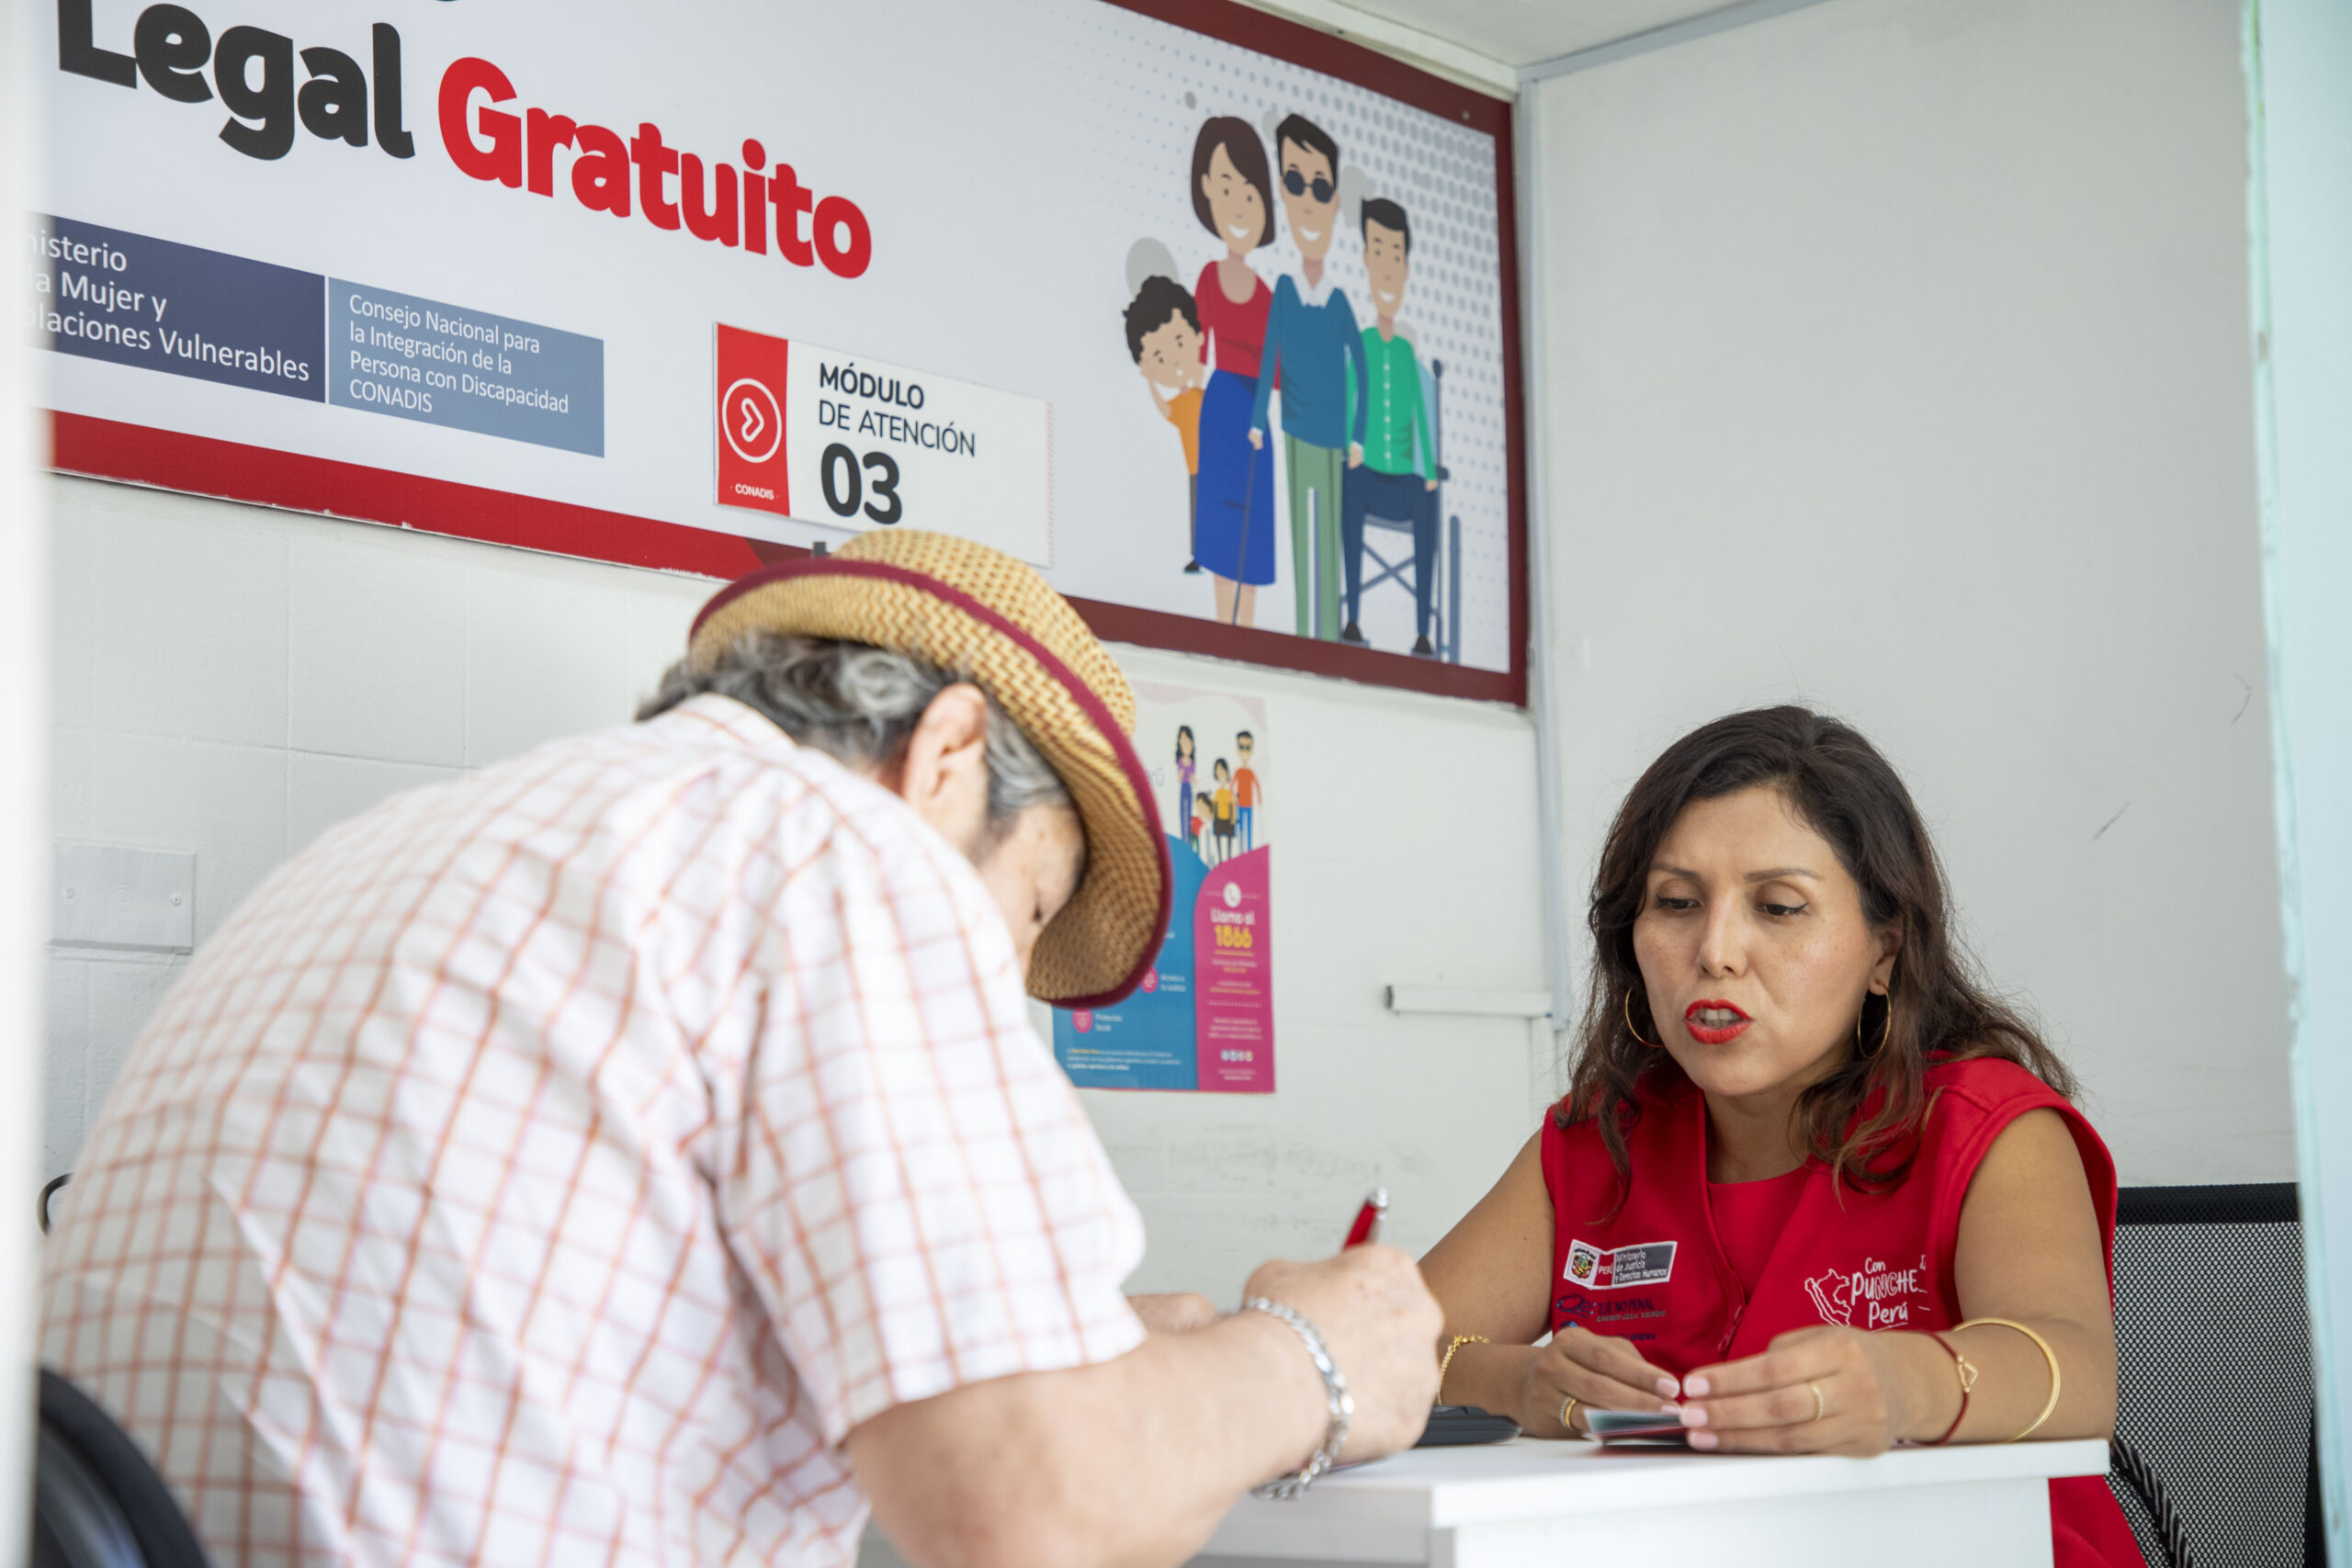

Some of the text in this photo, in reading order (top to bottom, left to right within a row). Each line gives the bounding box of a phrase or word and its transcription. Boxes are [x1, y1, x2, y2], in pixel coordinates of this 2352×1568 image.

[58, 0, 873, 280] Legal Gratuito
[23, 230, 128, 272] nisterio
[62, 271, 144, 313] Mujer
[152, 295, 167, 322] y
[349, 294, 540, 354] Consejo Nacional para
[350, 321, 512, 375] la Integración de la
[158, 327, 310, 382] Vulnerables
[350, 350, 569, 413] Persona con Discapacidad
[350, 378, 433, 412] CONADIS
[819, 362, 924, 410] MÓDULO
[819, 400, 976, 457] DE ATENCIÓN
[735, 483, 775, 500] CONADIS
[820, 443, 903, 525] 03
[1214, 924, 1253, 949] 1866
[1865, 1257, 1886, 1275] Con
[1869, 1301, 1909, 1329] Perú
